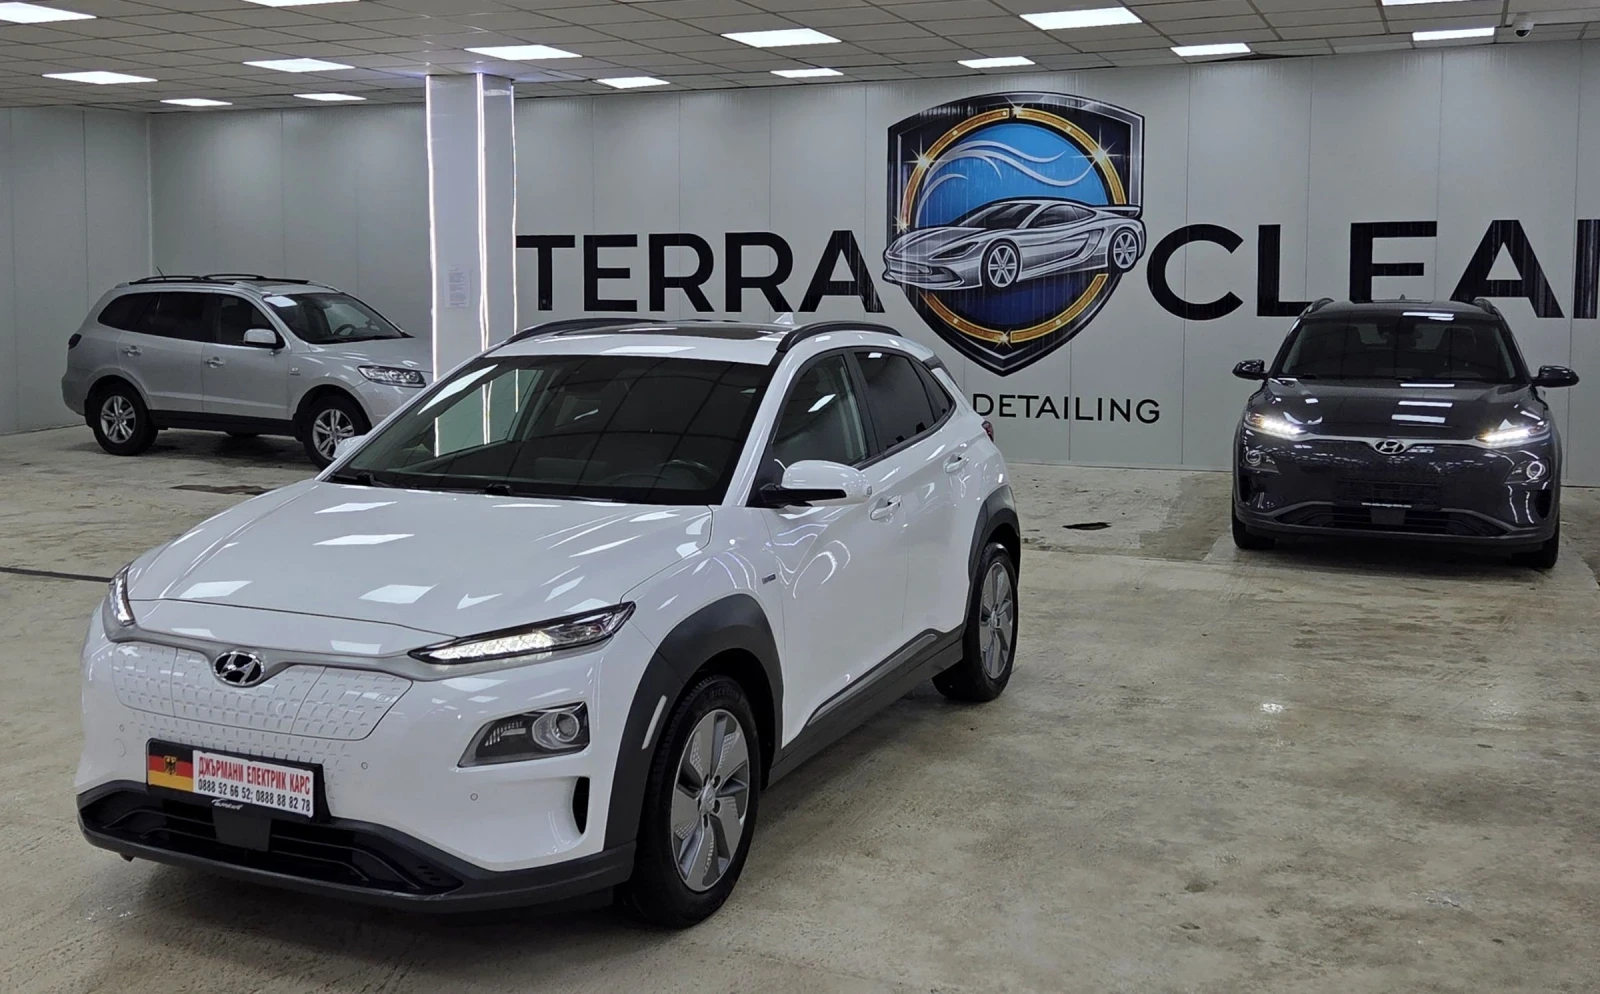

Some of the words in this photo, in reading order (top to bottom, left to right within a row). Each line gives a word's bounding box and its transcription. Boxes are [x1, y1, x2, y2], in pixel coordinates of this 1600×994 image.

[516, 230, 886, 312] TERRA
[973, 393, 1160, 424] DETAILING
[198, 756, 244, 782] ДЖЪРМАНИ
[247, 765, 287, 790] ЕЛЕКТРИК
[290, 773, 311, 795] КАРС
[198, 779, 216, 793] 0888
[218, 782, 227, 795] 52
[230, 785, 239, 798] 66
[256, 790, 274, 805] 0888
[277, 794, 286, 807] 88
[289, 796, 299, 810] 82
[301, 798, 310, 812] 78
